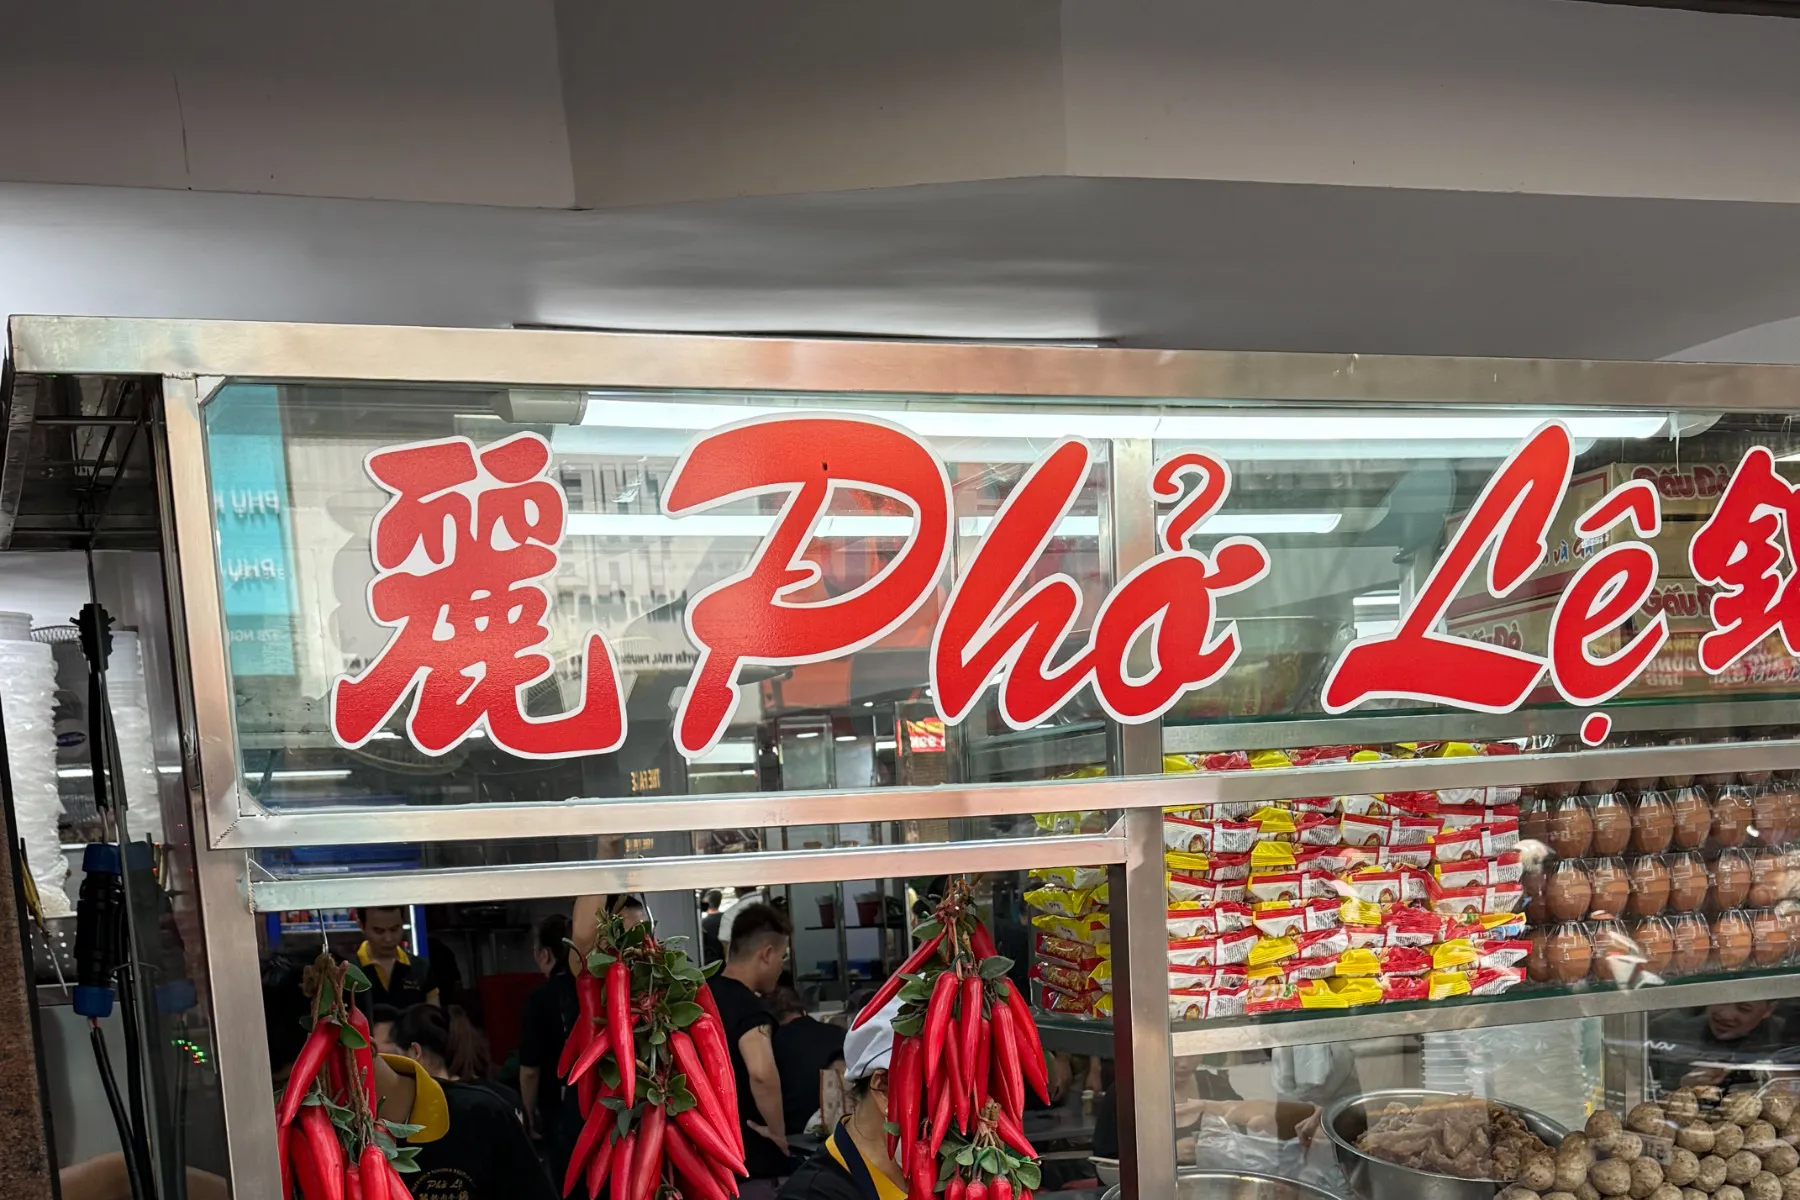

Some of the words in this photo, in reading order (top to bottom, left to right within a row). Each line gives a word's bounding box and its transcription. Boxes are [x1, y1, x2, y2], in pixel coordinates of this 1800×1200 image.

[331, 430, 627, 758] 麗
[660, 411, 1271, 759] Phở
[1321, 419, 1670, 747] Lệ
